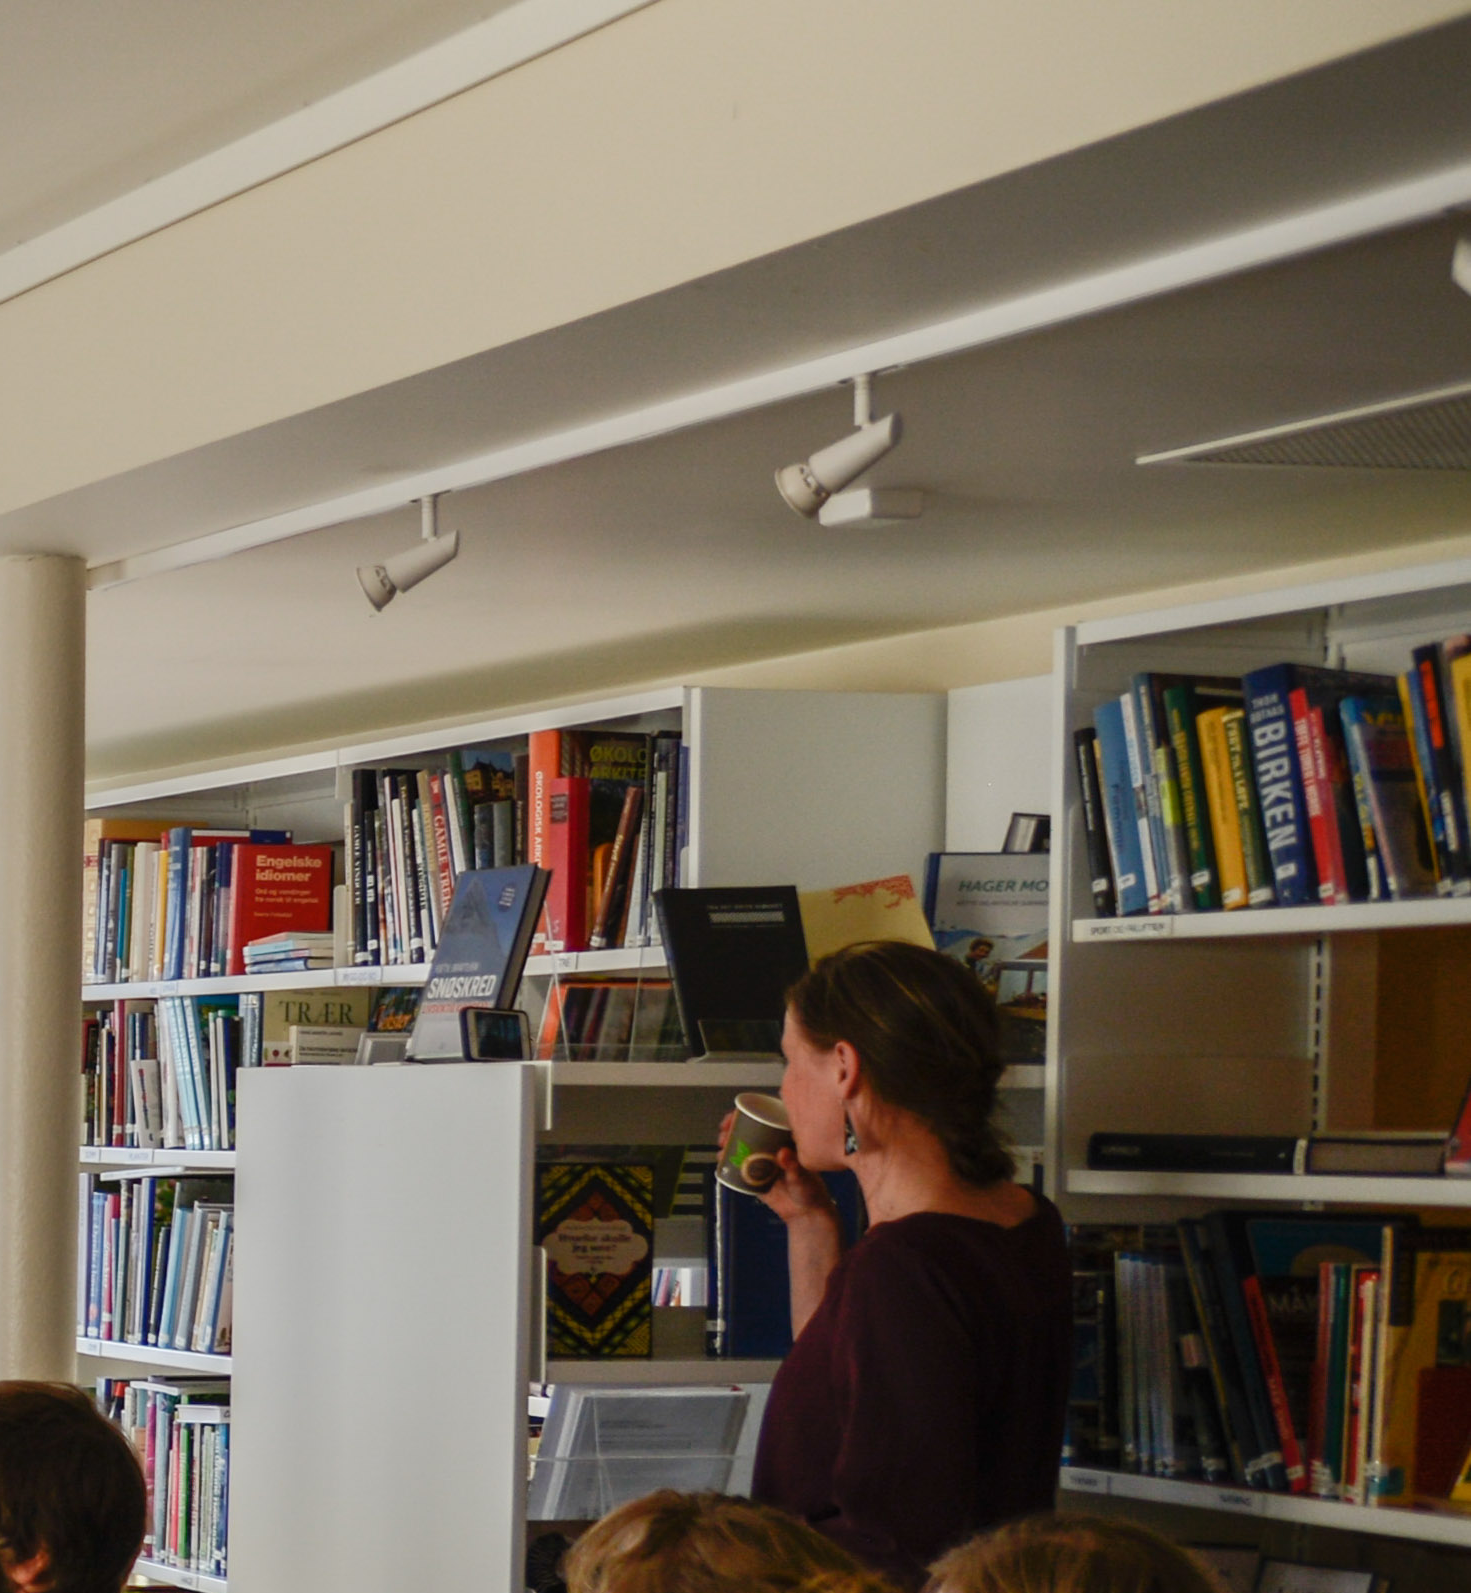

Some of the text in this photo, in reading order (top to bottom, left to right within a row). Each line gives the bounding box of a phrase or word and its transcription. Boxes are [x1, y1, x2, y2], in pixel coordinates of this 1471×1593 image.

[1253, 720, 1299, 851] BIRKEN
[534, 771, 543, 834] ØKOLOGISK
[434, 815, 449, 864] GAMLE
[256, 854, 322, 869] Engelske
[255, 869, 311, 881] idiomer
[958, 880, 1016, 892] HAGER
[427, 974, 497, 999] SNØSKRED
[279, 1001, 354, 1025] TRÆR
